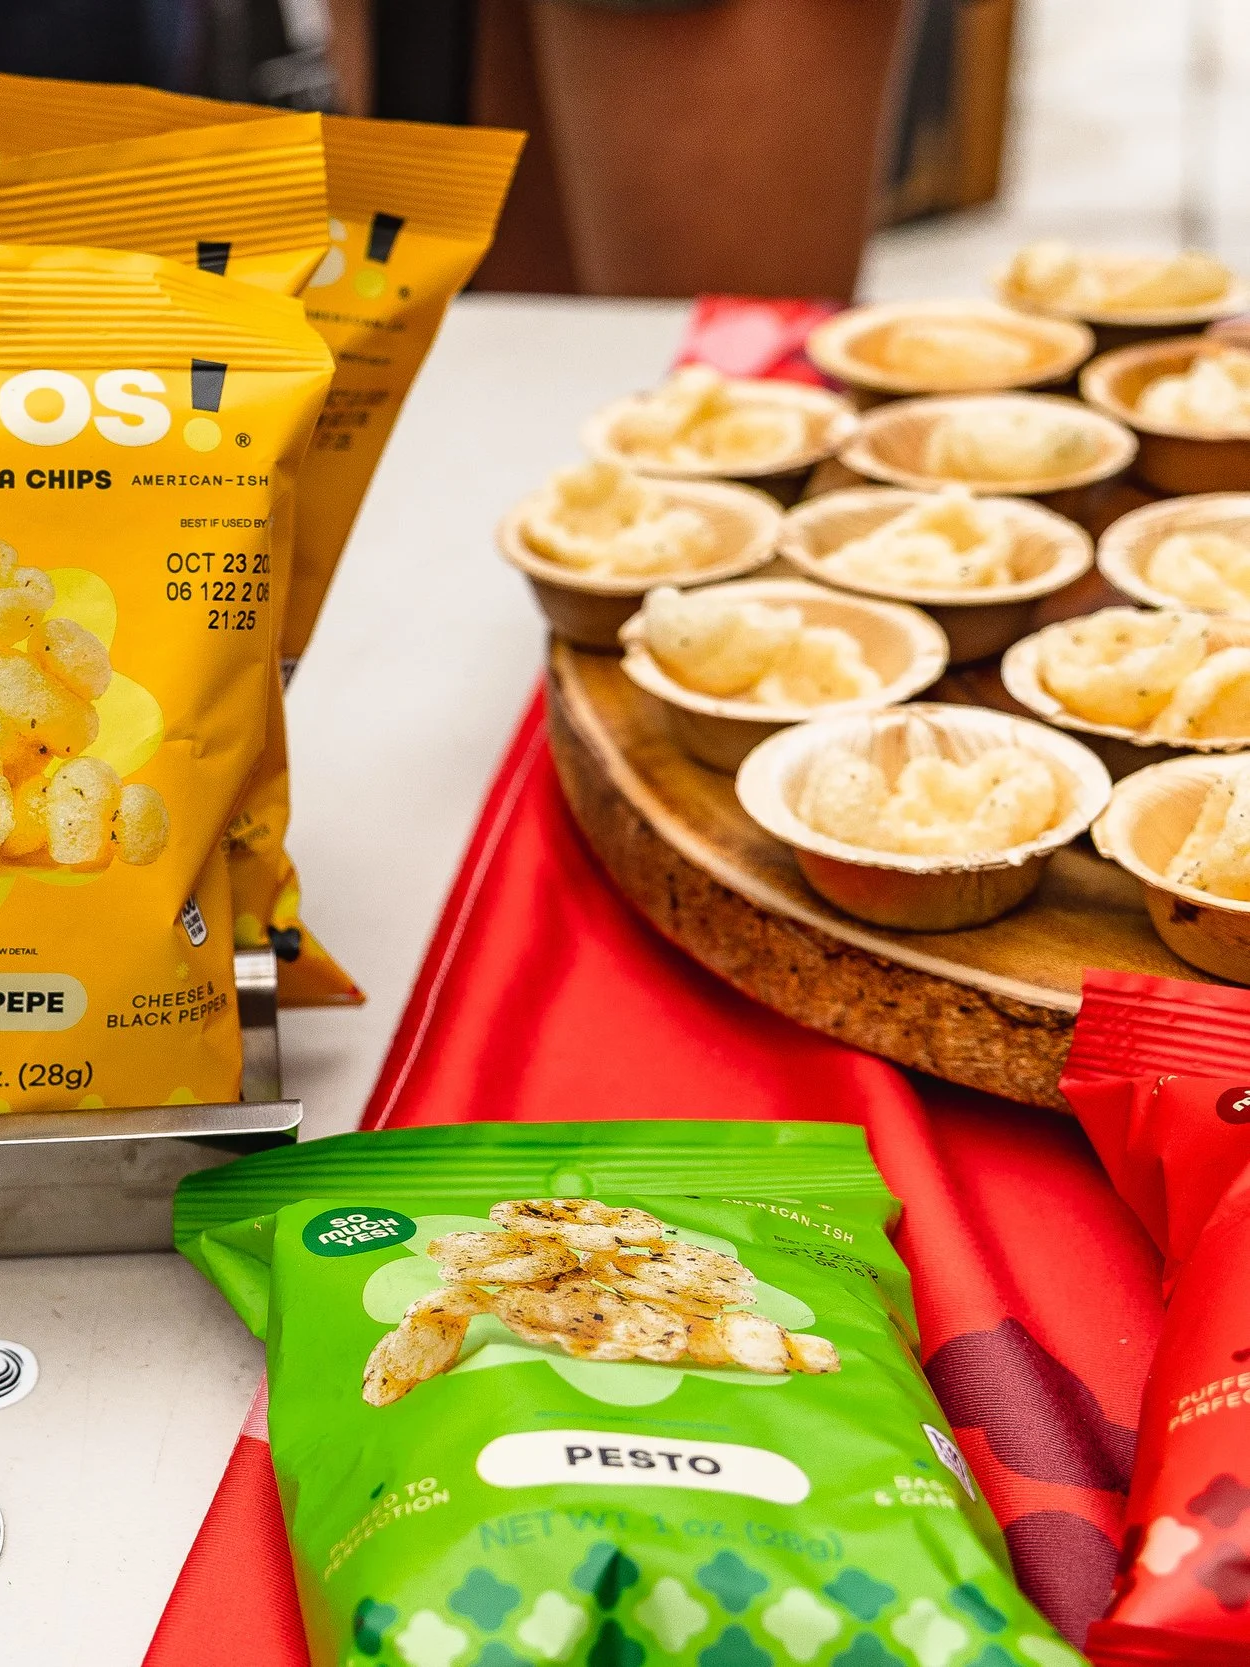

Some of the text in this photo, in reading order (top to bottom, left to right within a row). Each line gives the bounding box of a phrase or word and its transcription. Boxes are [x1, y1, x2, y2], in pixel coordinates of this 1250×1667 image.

[26, 469, 112, 490] CHIPS
[131, 475, 269, 487] AMERICAN-ISH
[180, 519, 267, 528] BEST IF USED BY
[166, 552, 215, 574] OCT
[223, 553, 247, 573] 23
[166, 581, 192, 601] 06
[200, 581, 236, 602] 122
[241, 582, 252, 602] 2
[208, 609, 256, 630] 21:25
[8, 947, 38, 955] DETAIL
[132, 980, 215, 1009] CHEESE &
[107, 992, 228, 1028] BLACK PEPPER
[18, 1061, 94, 1091] (28g)
[318, 1217, 400, 1245] MUCH
[329, 1213, 368, 1229] SO
[333, 1227, 399, 1247] YES!
[564, 1445, 722, 1475] PESTO
[405, 1477, 437, 1497] TO
[479, 1509, 554, 1549] NET
